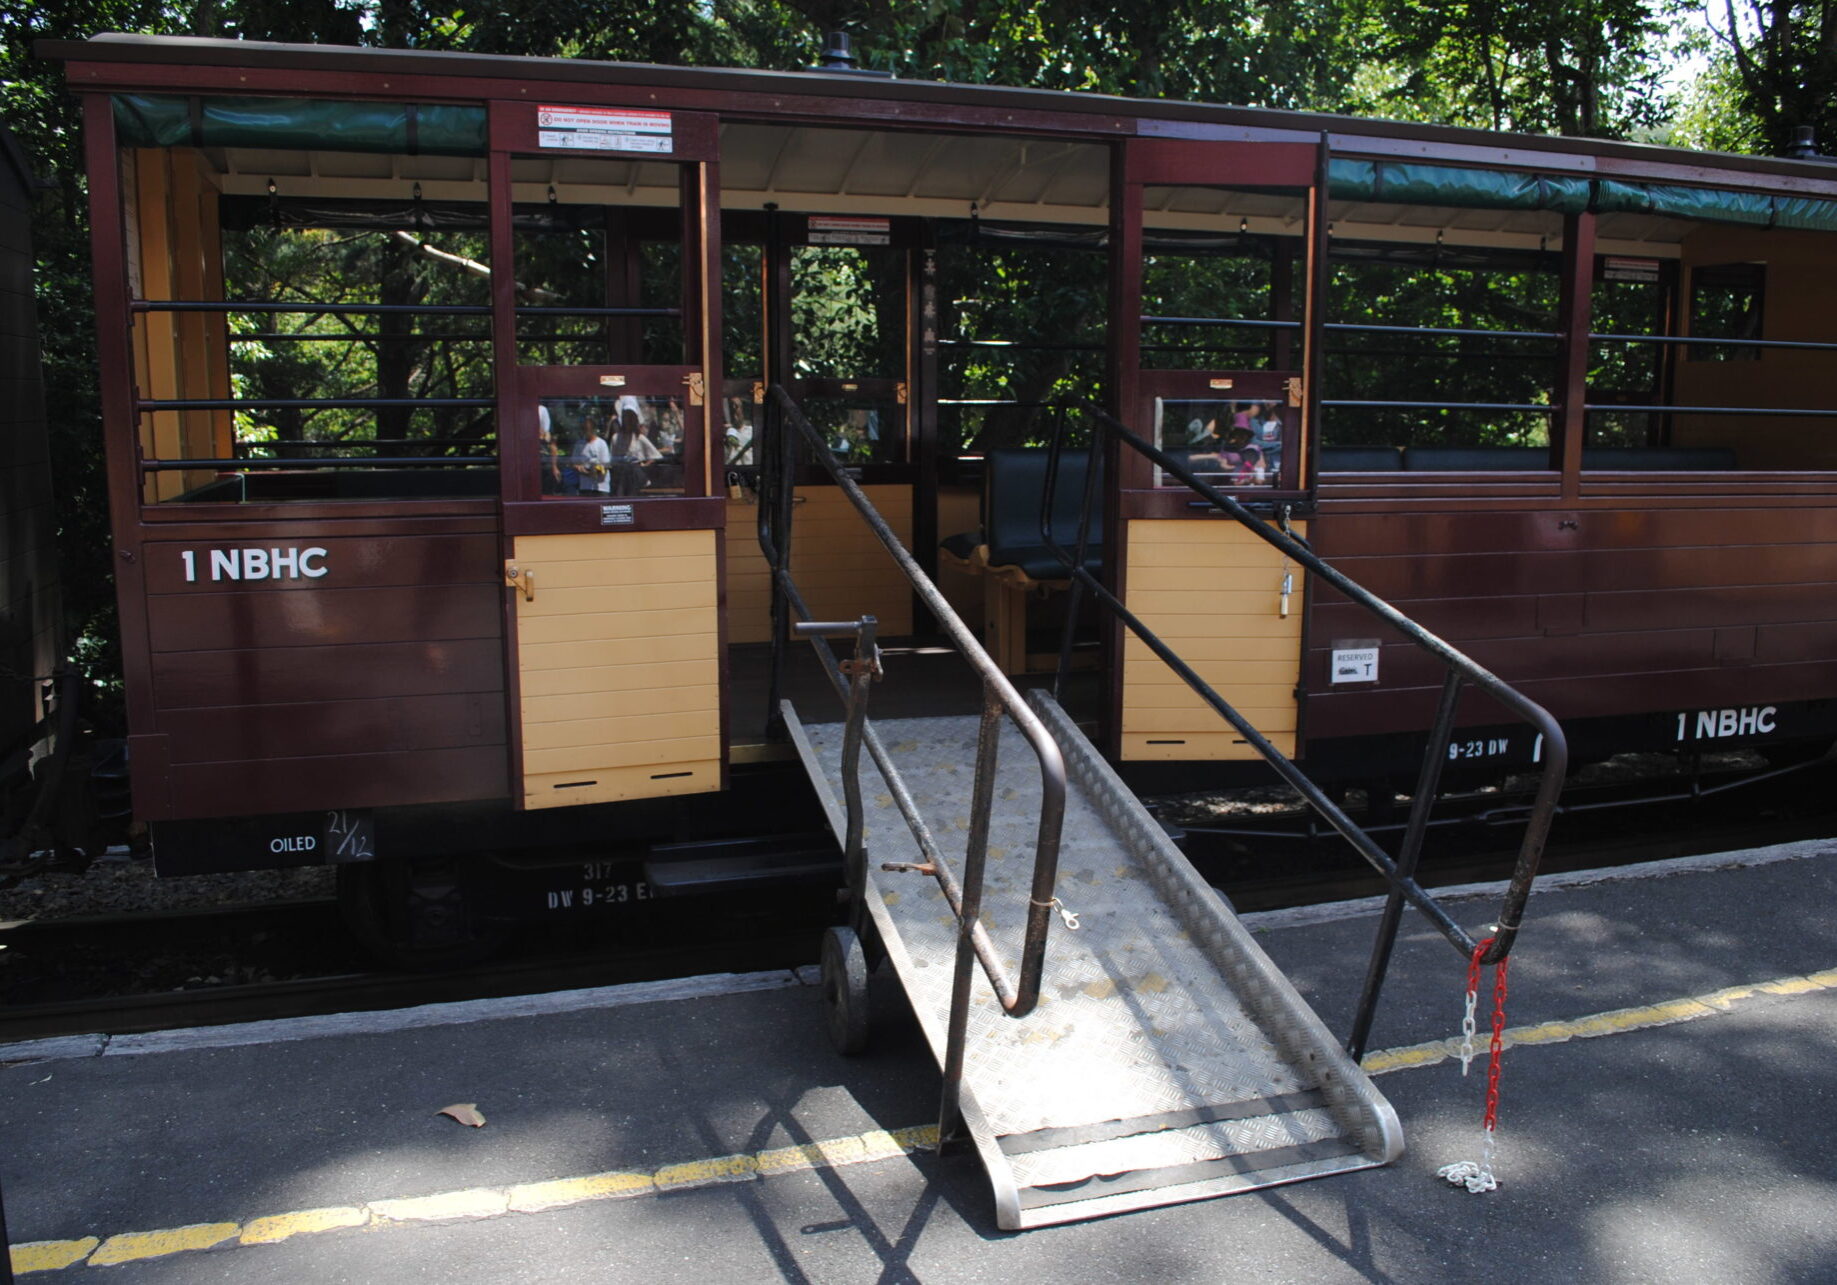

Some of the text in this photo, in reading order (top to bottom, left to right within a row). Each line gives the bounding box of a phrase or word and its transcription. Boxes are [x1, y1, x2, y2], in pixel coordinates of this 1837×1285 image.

[181, 547, 328, 581] 1 NBHC
[1337, 653, 1374, 661] RESERVED
[1677, 706, 1777, 741] 1 NBHC
[1449, 738, 1508, 760] 9-23 DW
[270, 836, 316, 853] OILED
[547, 890, 573, 909] DW
[582, 884, 628, 905] 9-23
